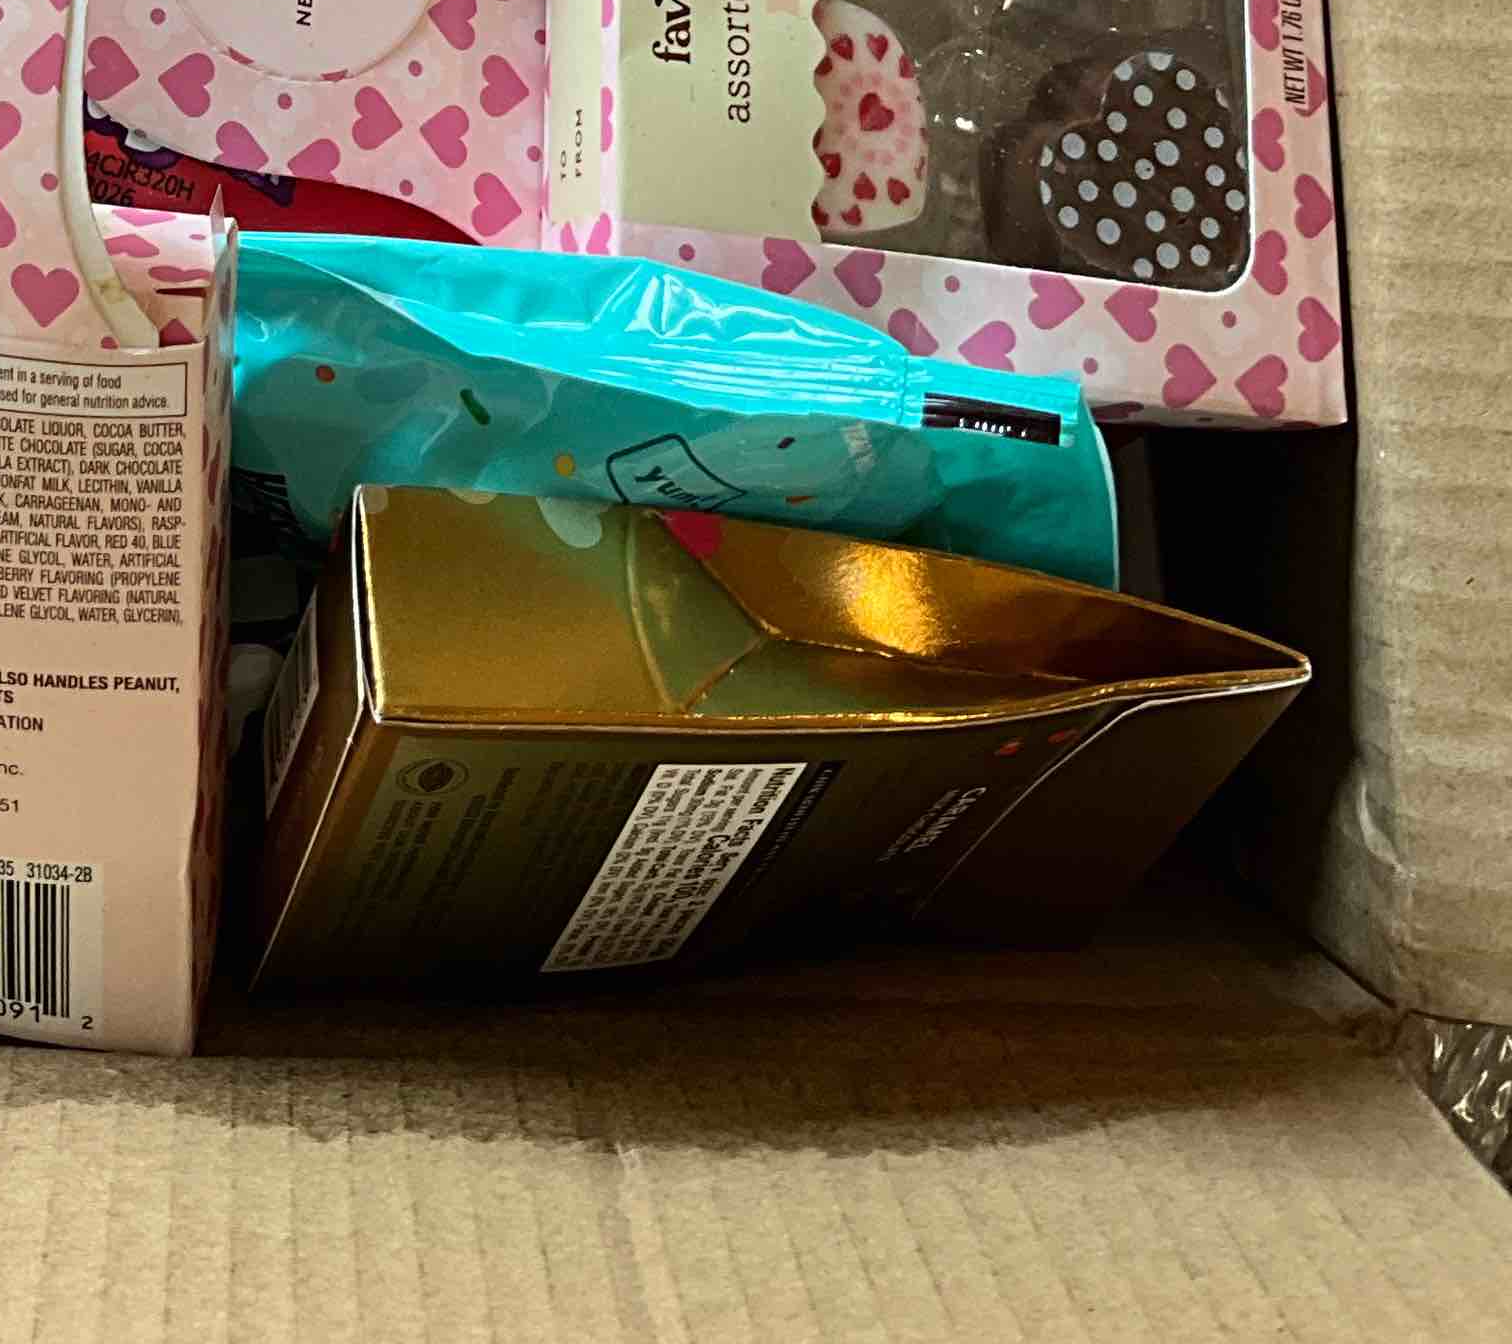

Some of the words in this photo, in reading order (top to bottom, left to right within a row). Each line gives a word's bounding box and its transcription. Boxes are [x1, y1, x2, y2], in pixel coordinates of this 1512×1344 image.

[1281, 10, 1303, 42] 1.76
[1283, 48, 1305, 71] WT
[1284, 73, 1306, 104] NET
[560, 150, 567, 182] TO
[33, 673, 109, 691] HANDLES
[114, 676, 180, 694] PEANUT,
[26, 863, 92, 882] 31034-2B
[82, 1016, 93, 1030] 2
